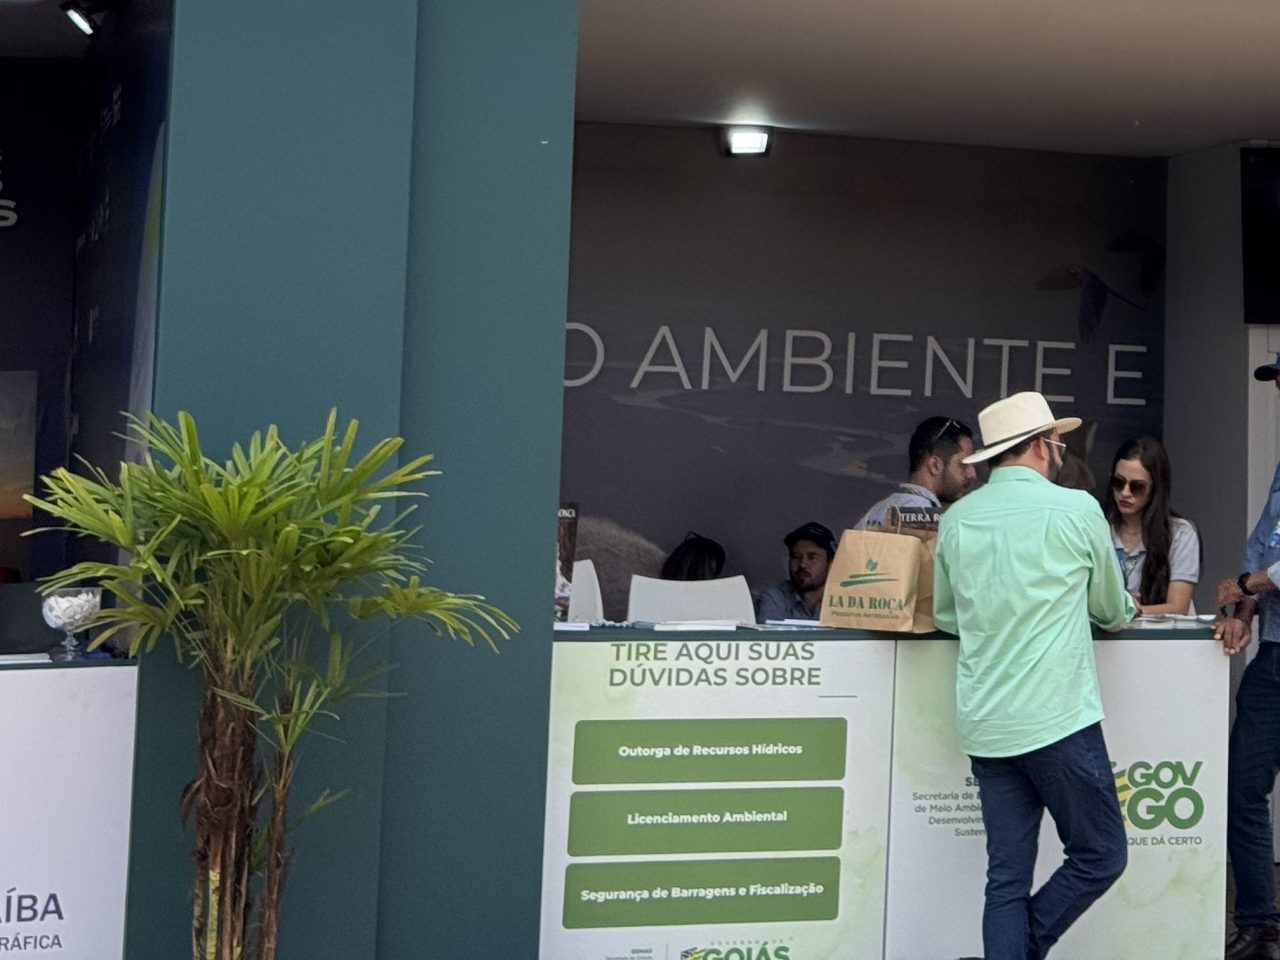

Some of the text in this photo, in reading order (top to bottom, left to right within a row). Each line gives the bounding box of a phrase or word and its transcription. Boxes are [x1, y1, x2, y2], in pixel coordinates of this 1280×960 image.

[630, 326, 1075, 403] AMBIENTE
[1106, 345, 1147, 406] E
[901, 513, 931, 522] TERRA
[848, 596, 864, 609] DA
[869, 596, 904, 614] ROÇA
[610, 643, 815, 664] TIRE AQUI SUAS
[608, 663, 822, 687] DÚVIDAS SOBRE
[618, 743, 803, 758] Outorga de Recursos Hídricos
[1127, 761, 1203, 788] GOV
[912, 791, 959, 800] Secretaria
[961, 791, 974, 800] de
[914, 804, 927, 812] de
[929, 804, 952, 812] Meio
[1127, 787, 1204, 830] GO
[627, 811, 787, 825] Licenciamento Ambiental
[1150, 834, 1166, 846] DÁ
[1168, 836, 1202, 846] CERTO
[580, 883, 824, 902] Segurança de Barragens e Fiscalização
[0, 887, 64, 923] ÍBA
